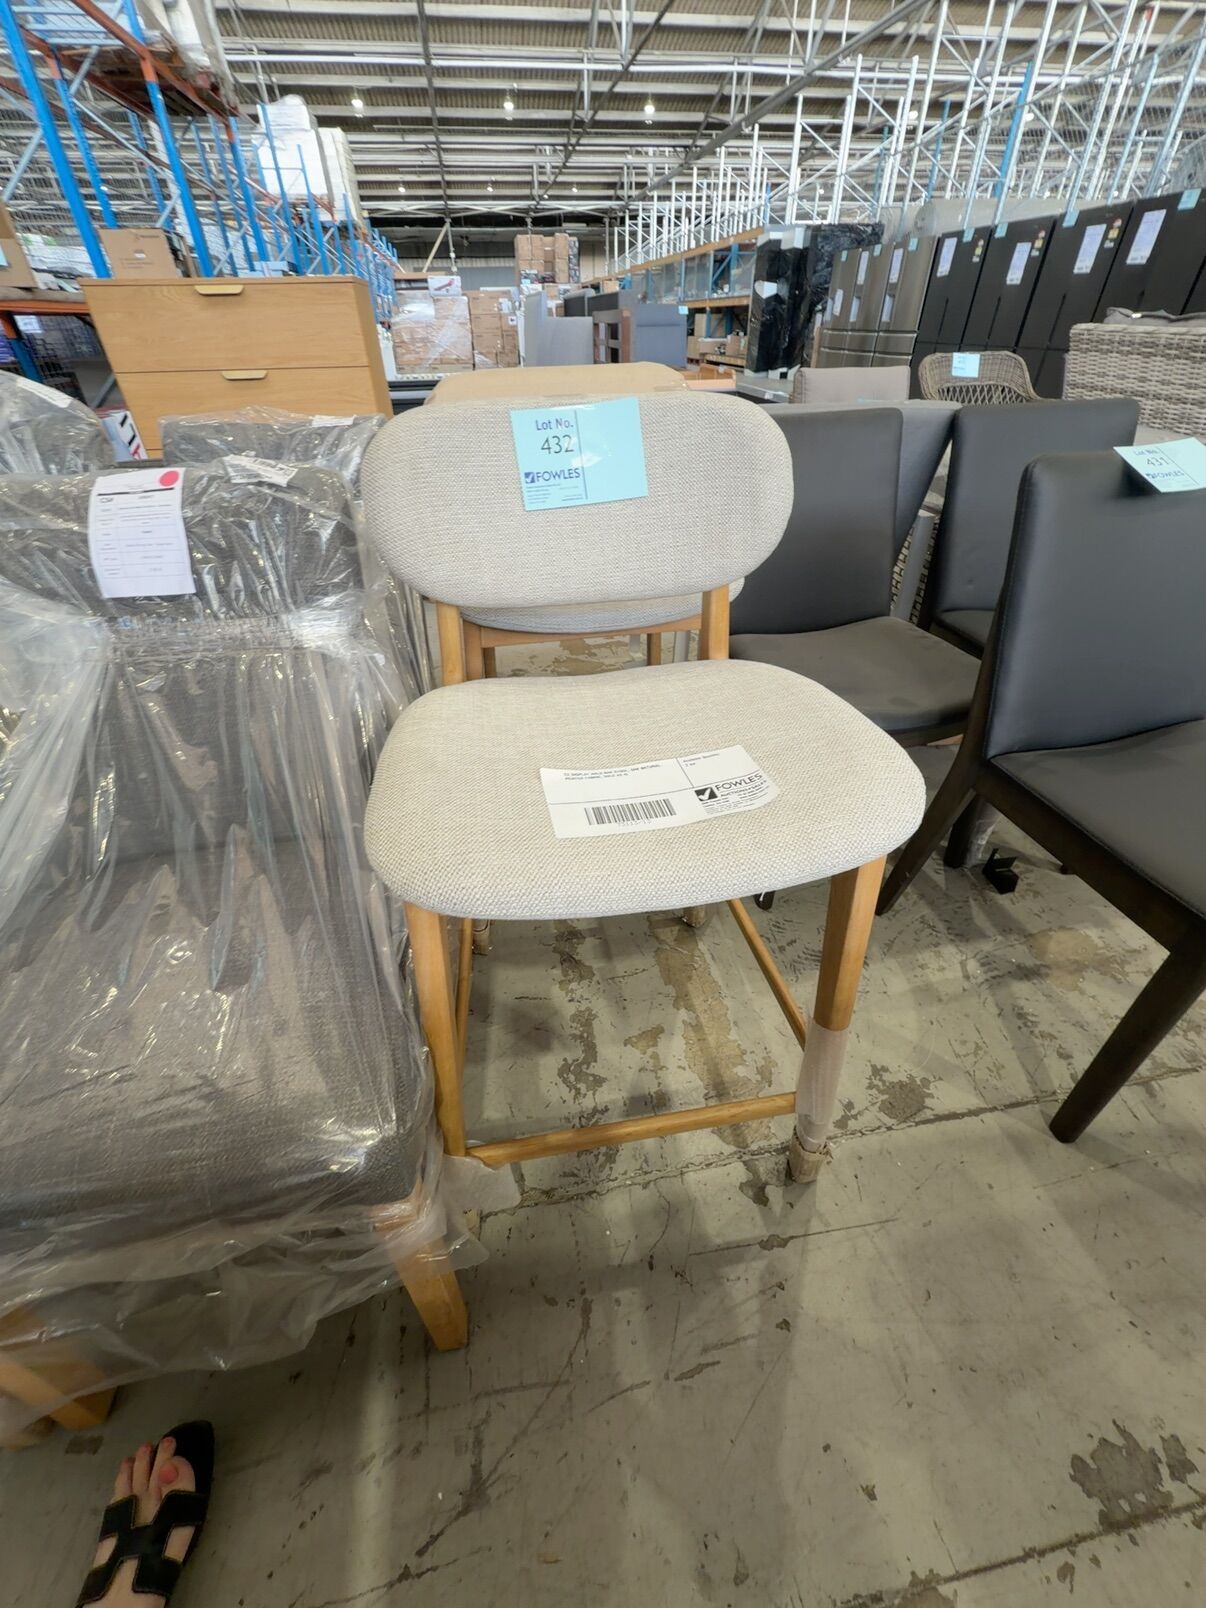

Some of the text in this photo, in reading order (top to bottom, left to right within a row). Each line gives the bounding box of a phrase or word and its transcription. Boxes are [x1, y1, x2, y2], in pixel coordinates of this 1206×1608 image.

[535, 417, 575, 431] Lot No.
[540, 434, 575, 454] 432
[536, 468, 581, 482] FOWLES
[714, 773, 763, 792] FOWLES
